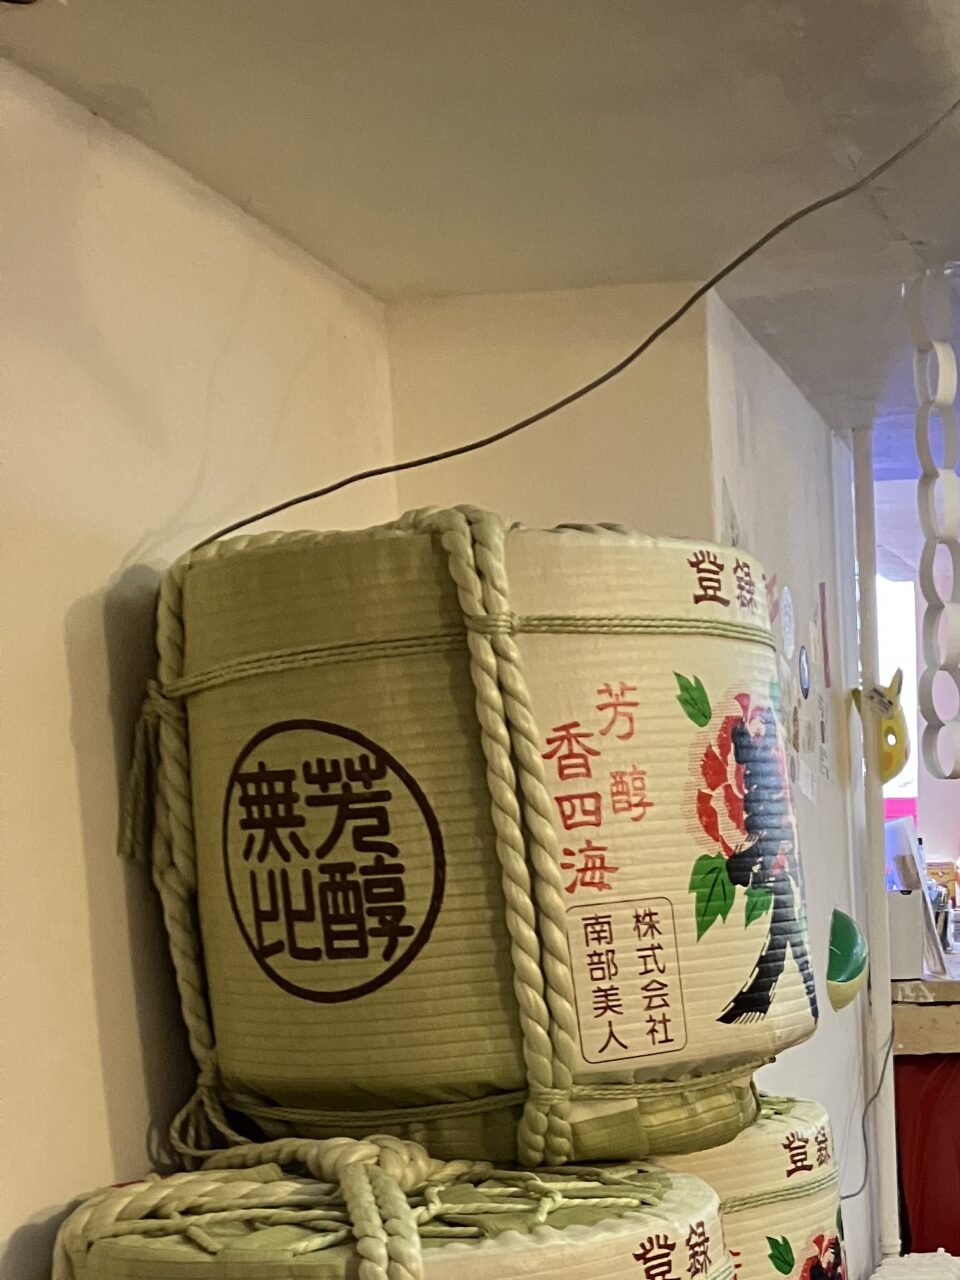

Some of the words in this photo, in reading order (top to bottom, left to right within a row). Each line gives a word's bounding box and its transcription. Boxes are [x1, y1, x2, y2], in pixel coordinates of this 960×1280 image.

[541, 720, 620, 895] 香四海
[596, 680, 655, 822] 芳醇
[581, 913, 628, 1054] 南部美人
[632, 907, 674, 1046] 株式会社
